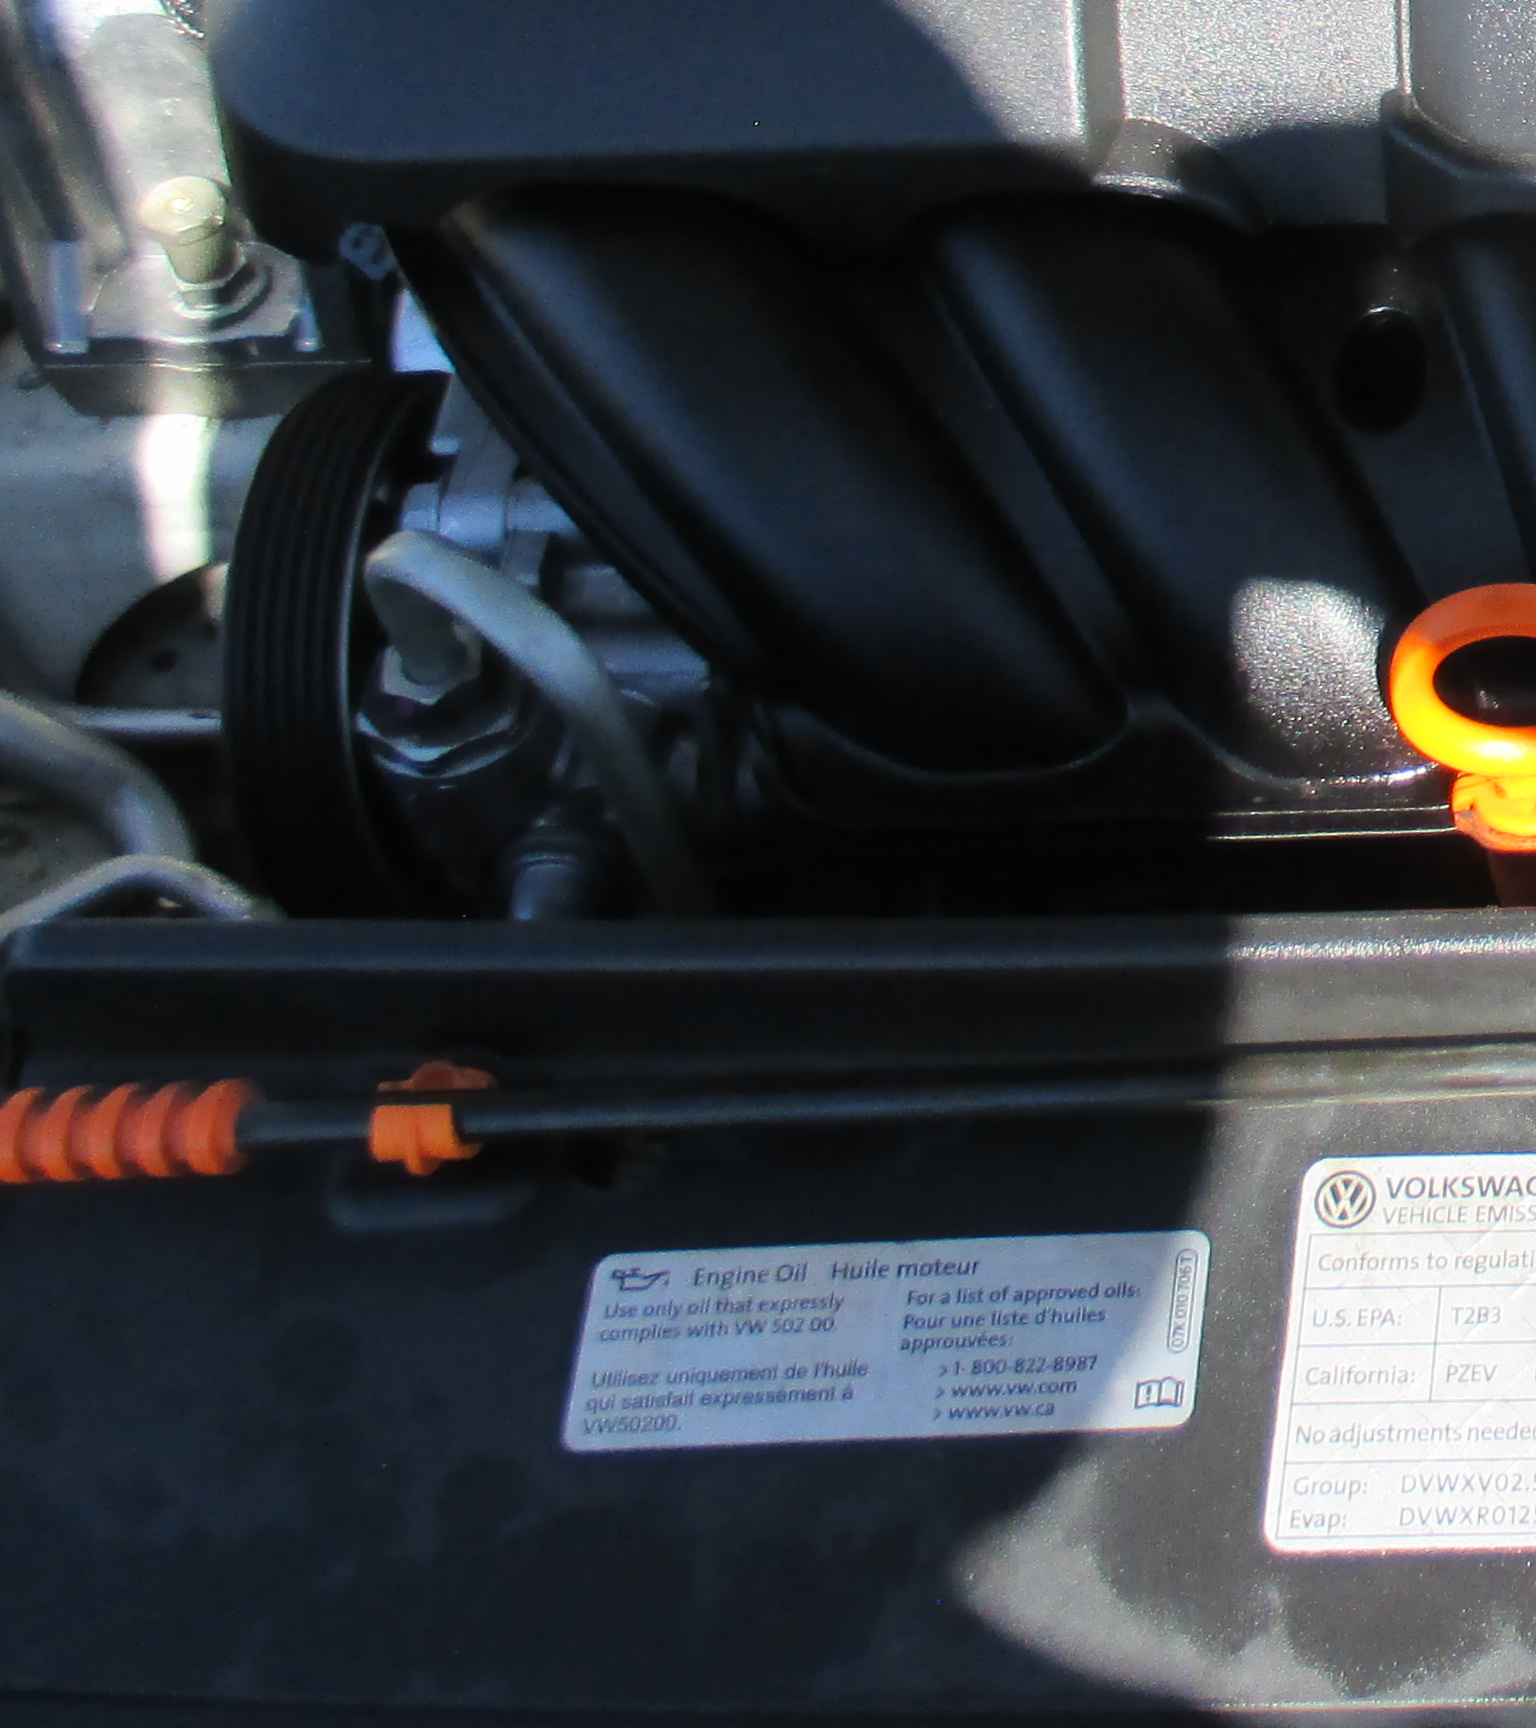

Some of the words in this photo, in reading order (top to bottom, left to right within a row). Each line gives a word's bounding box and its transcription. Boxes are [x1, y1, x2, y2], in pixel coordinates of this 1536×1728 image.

[1382, 1206, 1468, 1224] VEHICLE
[1317, 1252, 1420, 1271] Conforms
[1426, 1251, 1448, 1269] to
[692, 1264, 770, 1290] Engine
[775, 1262, 807, 1282] Oil
[831, 1259, 889, 1280] Huile
[897, 1256, 980, 1277] moteur
[906, 1290, 936, 1305] For
[940, 1293, 950, 1304] a
[956, 1288, 983, 1303] list
[989, 1287, 1009, 1302] of
[1012, 1283, 1098, 1304] approved
[1104, 1282, 1140, 1297] oils:
[604, 1302, 640, 1317] Use
[641, 1301, 682, 1319] only
[688, 1299, 710, 1314] oil
[714, 1298, 753, 1313] that
[757, 1294, 844, 1315] expressly
[1450, 1306, 1501, 1324] T2B3
[902, 1313, 946, 1329] Pour
[950, 1315, 985, 1327] une
[991, 1309, 1028, 1325] liste
[1311, 1309, 1352, 1327] U.S.
[1357, 1308, 1403, 1326] EPA:
[598, 1322, 681, 1343] complies
[686, 1320, 729, 1336] with
[734, 1318, 766, 1334] VW
[771, 1317, 804, 1332] 502
[899, 1331, 1013, 1354] approuvées:
[1304, 1364, 1416, 1385] California:
[1445, 1364, 1497, 1382] PZEV
[951, 1381, 1077, 1396] www.vw.com
[948, 1403, 1055, 1419] www.vw.ca
[1294, 1425, 1326, 1444] No
[1328, 1422, 1464, 1448] adjustments
[1292, 1476, 1368, 1500] Group:
[1288, 1508, 1347, 1534] Evap:
